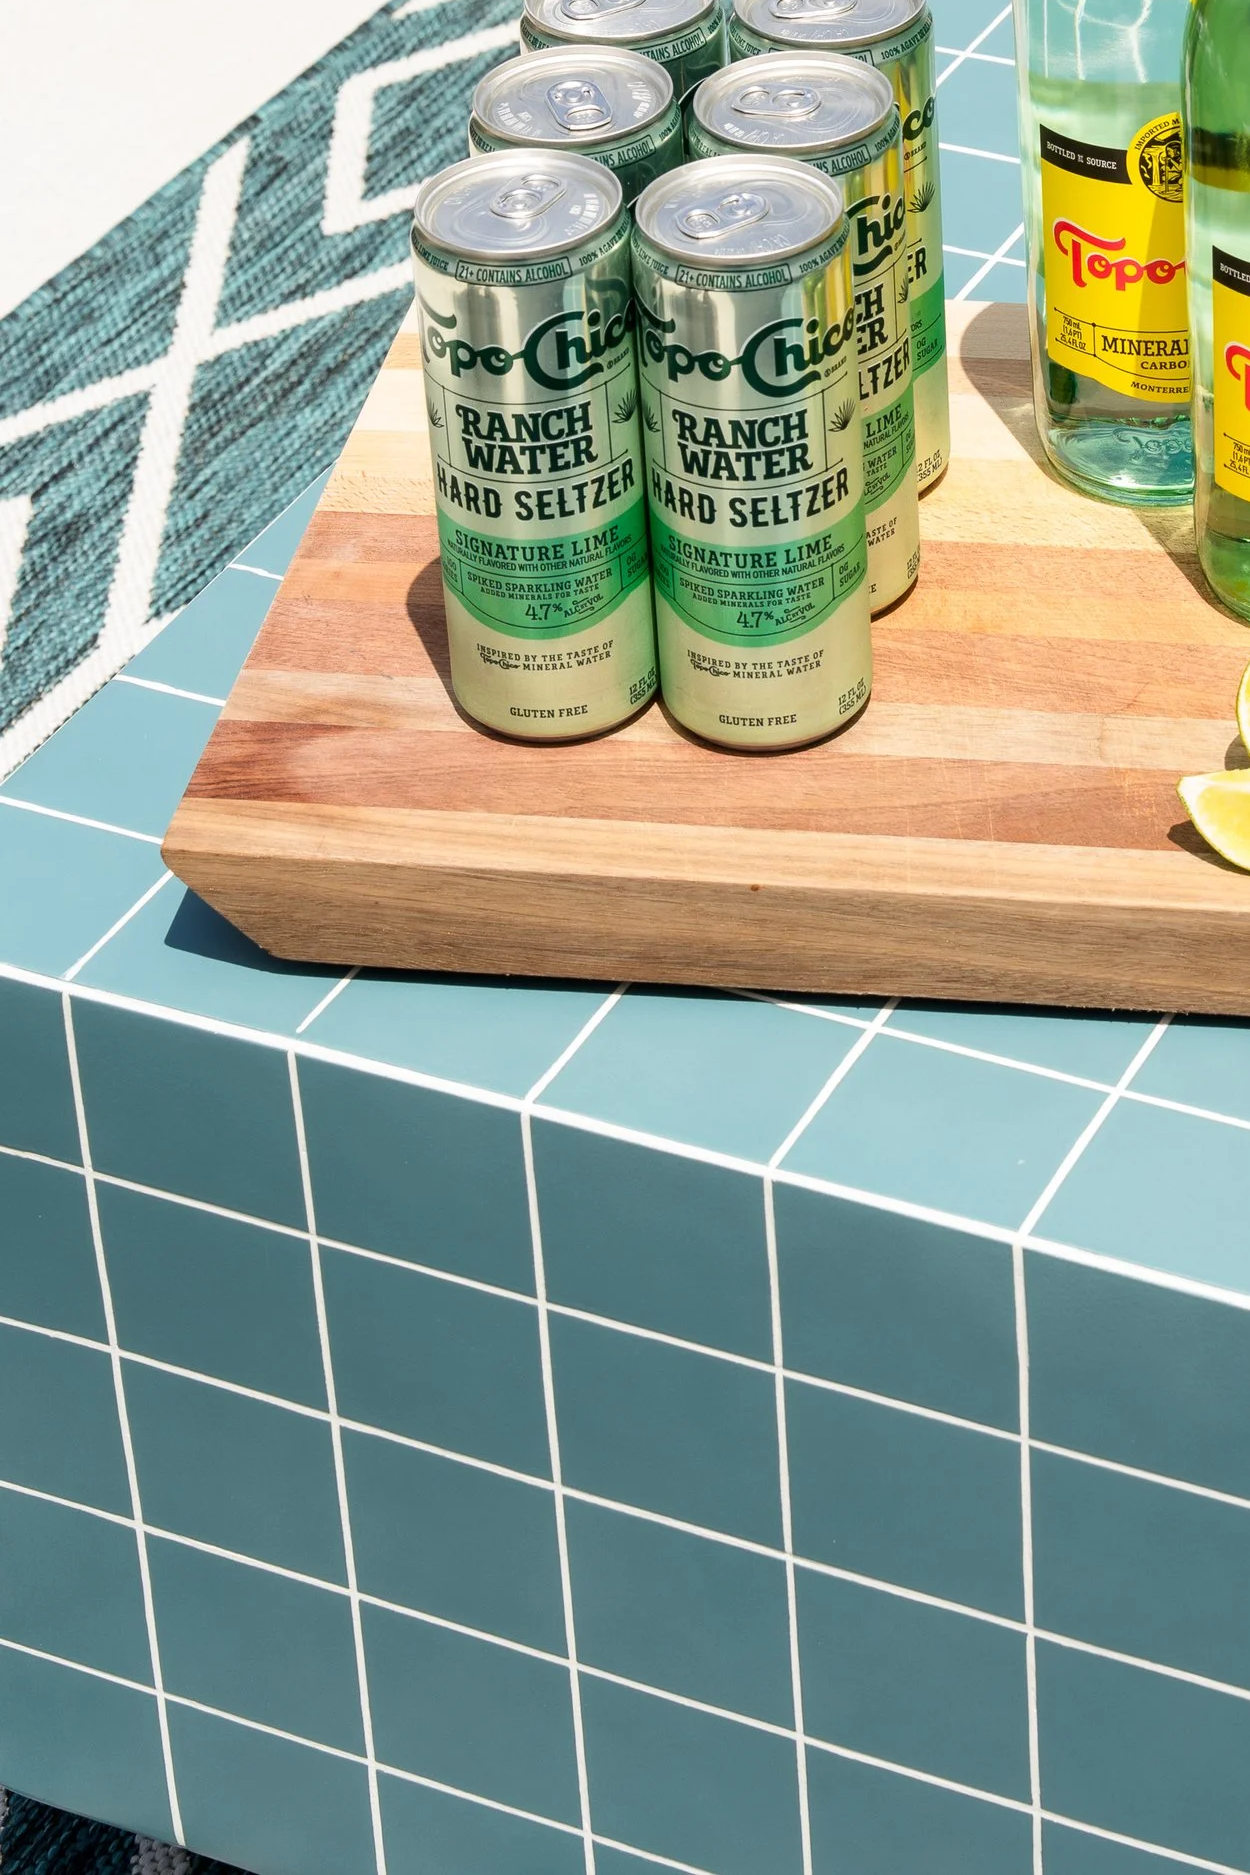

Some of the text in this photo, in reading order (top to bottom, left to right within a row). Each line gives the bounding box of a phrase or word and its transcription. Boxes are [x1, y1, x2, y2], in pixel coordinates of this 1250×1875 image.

[671, 32, 704, 57] ALCOHOL
[881, 45, 901, 60] 100%
[900, 34, 920, 53] AGAVE
[1134, 120, 1170, 151] IMPORTED
[617, 140, 654, 164] ALCOHOL
[831, 149, 869, 173] ALCOHOL
[1046, 141, 1076, 161] BOTTLED
[1086, 156, 1117, 170] SOURCE
[579, 250, 599, 266] 100%
[798, 243, 839, 274] 100% AGAVE
[1053, 217, 1177, 292] Topo
[458, 262, 568, 284] 21+ CONTAINS ALCOHOL
[678, 268, 789, 290] 21+ CONTAINS ALCOHOL
[417, 295, 634, 391] Topo Chico
[635, 293, 735, 383] Topo
[734, 305, 855, 398] Chico
[916, 338, 938, 361] SUGAR
[858, 336, 911, 402] LTZER
[1130, 380, 1189, 394] MONTERRE
[455, 400, 593, 443] RANCH
[672, 408, 809, 450] RANCH
[866, 403, 903, 439] LIME
[462, 433, 598, 475] WATER
[677, 441, 814, 482] WATER
[868, 446, 897, 469] WATER
[924, 448, 941, 469] FL OZ
[436, 457, 635, 521] HARD SELTZER
[651, 465, 849, 528] HARD SELTZER
[866, 516, 898, 540] ASTE OF
[867, 527, 896, 547] WATER
[447, 538, 478, 564] NATURALLY
[478, 555, 517, 572] FLAVORED
[517, 562, 540, 573] WITH
[540, 561, 568, 572] OTHER
[568, 552, 605, 569] NATURAL
[604, 535, 633, 557] FLAVORS
[455, 525, 619, 562] SIGNATURE LIME
[668, 534, 833, 569] SIGNATURE LIME
[691, 562, 729, 579] FLAVORED
[730, 570, 752, 580] WITH
[752, 569, 780, 579] OTHER
[781, 559, 818, 577] NATURAL
[817, 544, 845, 565] FLAVORS
[839, 562, 862, 588] SUGAR
[467, 567, 613, 593] SPIKED SPARKLING WATER
[480, 582, 600, 601] ADDED MINERALS FOR TASTE
[679, 576, 825, 601] SPIKED SPARKLING WATER
[524, 593, 604, 621] 4.7% ALC VOL
[692, 591, 812, 608] ADDED MINERALS FOR TASTE
[736, 602, 816, 629] 4.7% ALC VOL
[476, 639, 614, 663] INSPIRED BY THE TASTE OF
[522, 661, 573, 671] MINERAL
[577, 650, 612, 667] WATER
[687, 649, 824, 671] INSPIRED BY THE TASTE OF
[732, 670, 783, 680] MINERAL
[787, 660, 822, 676] WATER
[629, 683, 637, 696] 12
[638, 676, 647, 689] FL
[630, 686, 646, 705] (355
[838, 677, 865, 707] 12 FL OZ
[509, 704, 588, 719] GLUTEN FREE
[838, 686, 867, 715] (355 ML)
[719, 714, 797, 727] GLUTEN FREE
